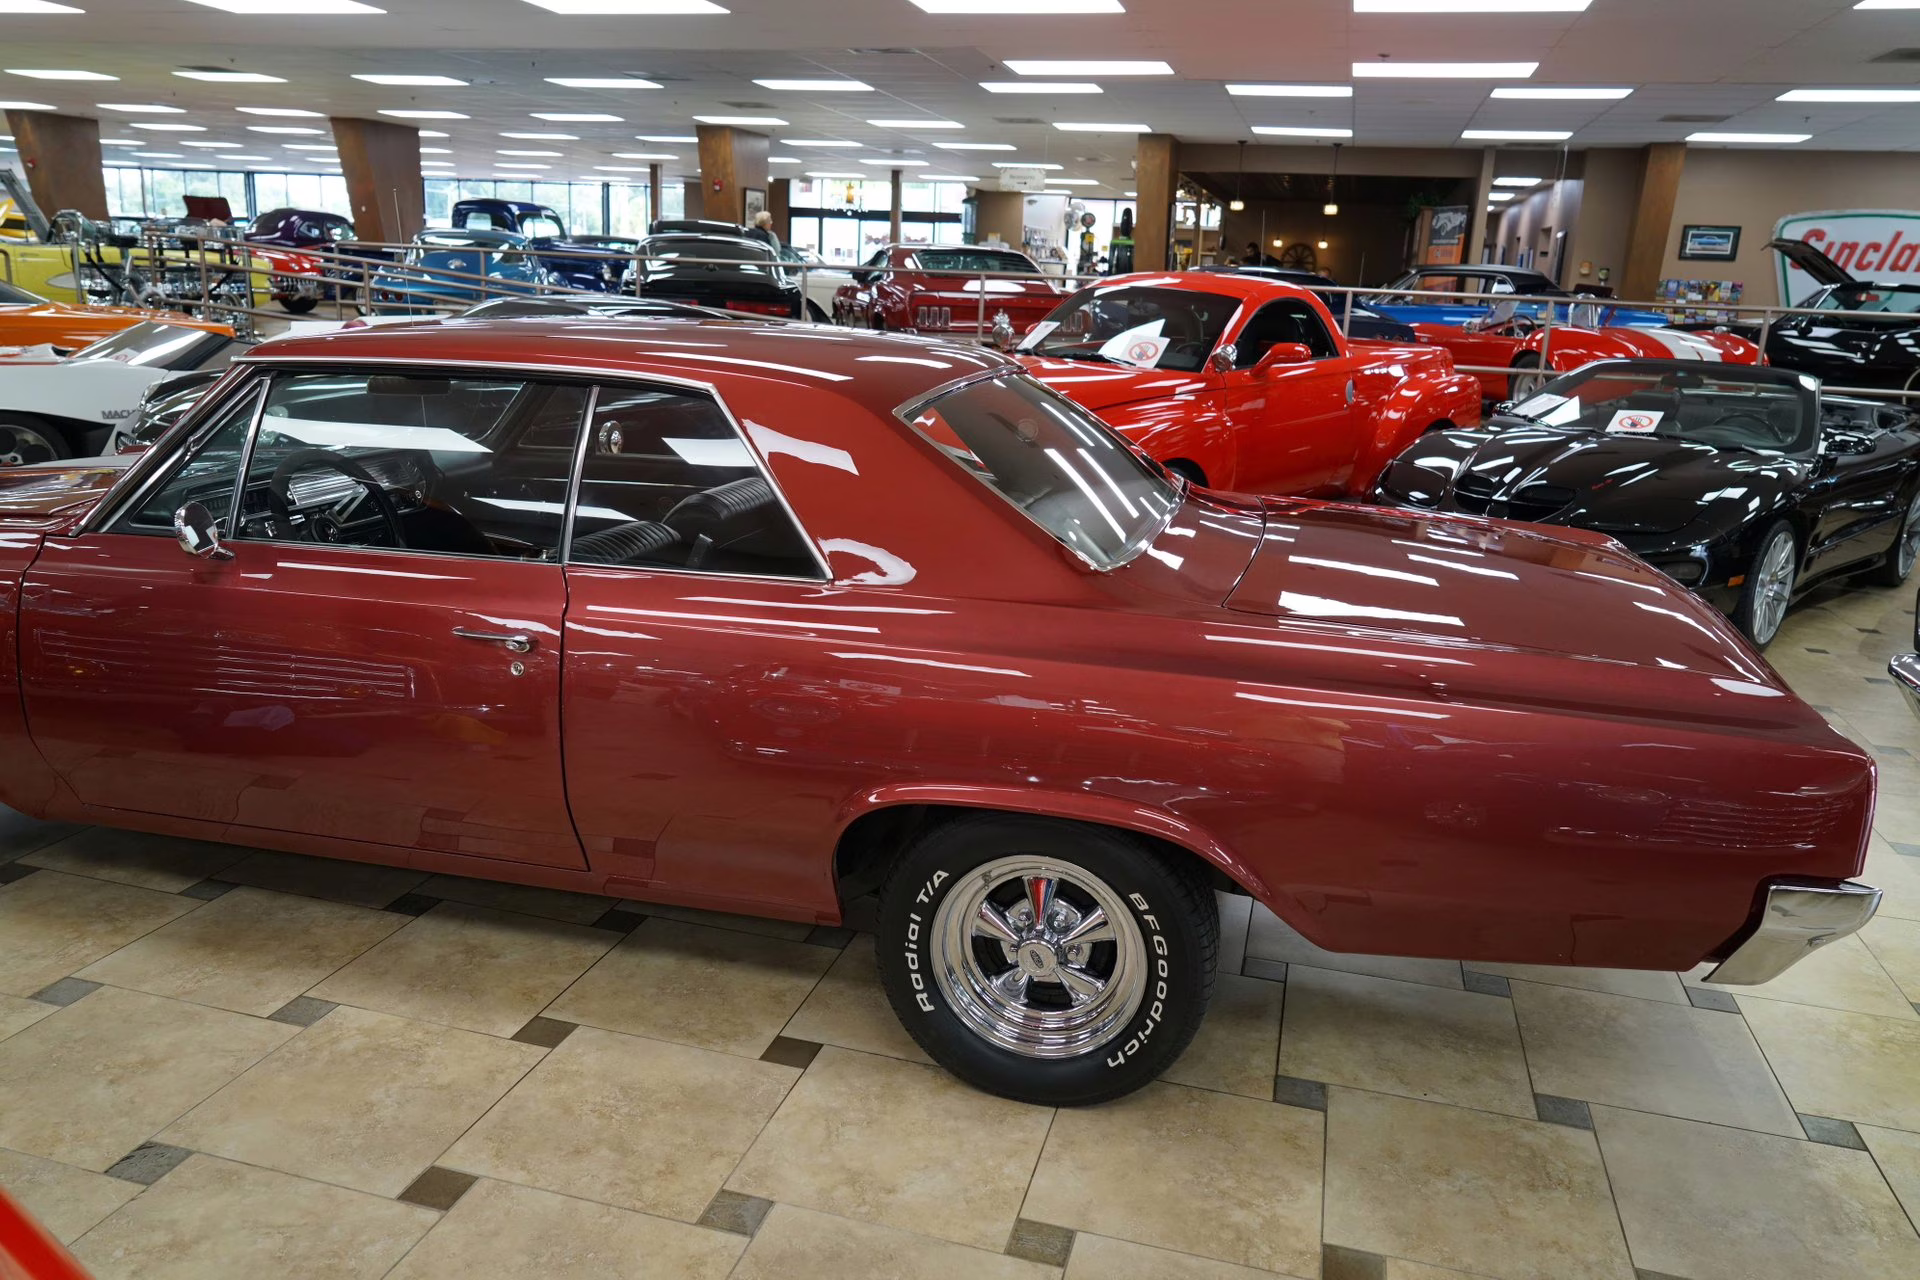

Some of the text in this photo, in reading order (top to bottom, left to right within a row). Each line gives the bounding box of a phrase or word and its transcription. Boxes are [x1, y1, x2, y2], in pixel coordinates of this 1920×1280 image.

[1790, 228, 1920, 273] Sincla
[905, 870, 950, 1012] Radial T/A
[1107, 892, 1169, 1068] BFGoodrich
